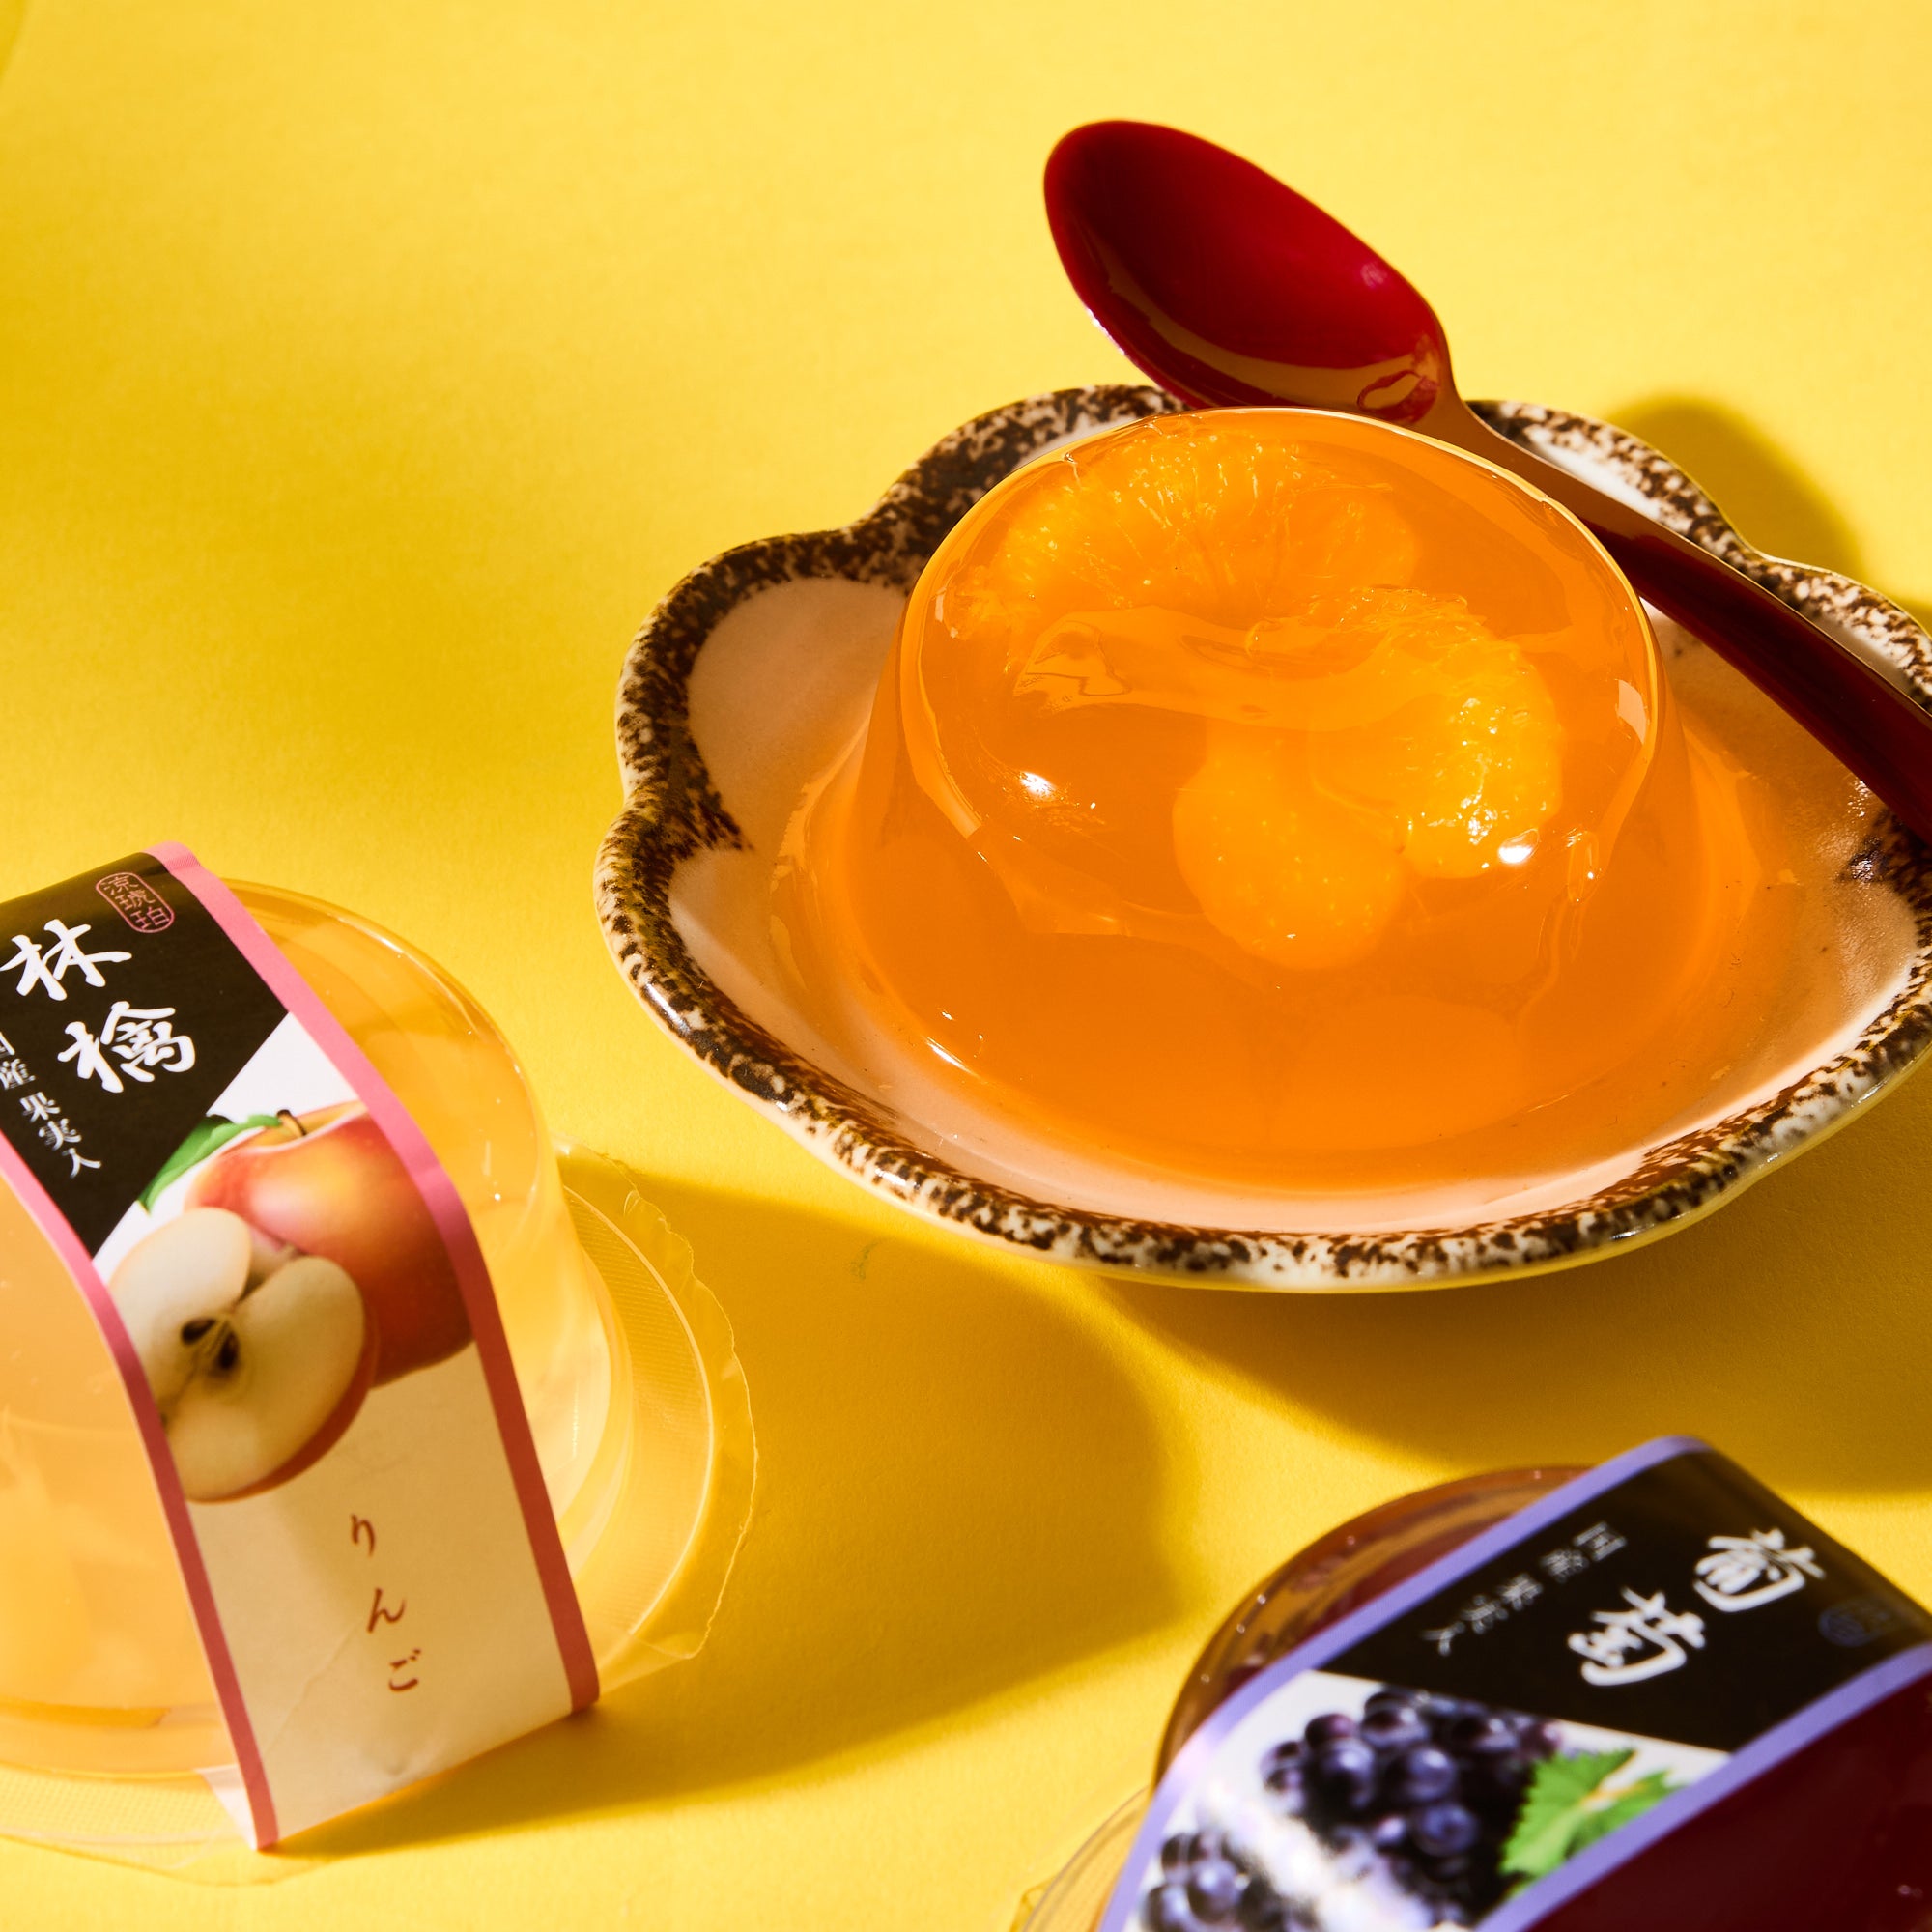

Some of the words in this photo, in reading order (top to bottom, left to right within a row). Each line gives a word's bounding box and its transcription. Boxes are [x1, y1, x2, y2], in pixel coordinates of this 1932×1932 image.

[0, 919, 196, 1093] 林檎
[350, 1514, 422, 1692] りんご
[1568, 1528, 1826, 1688] 葡萄
